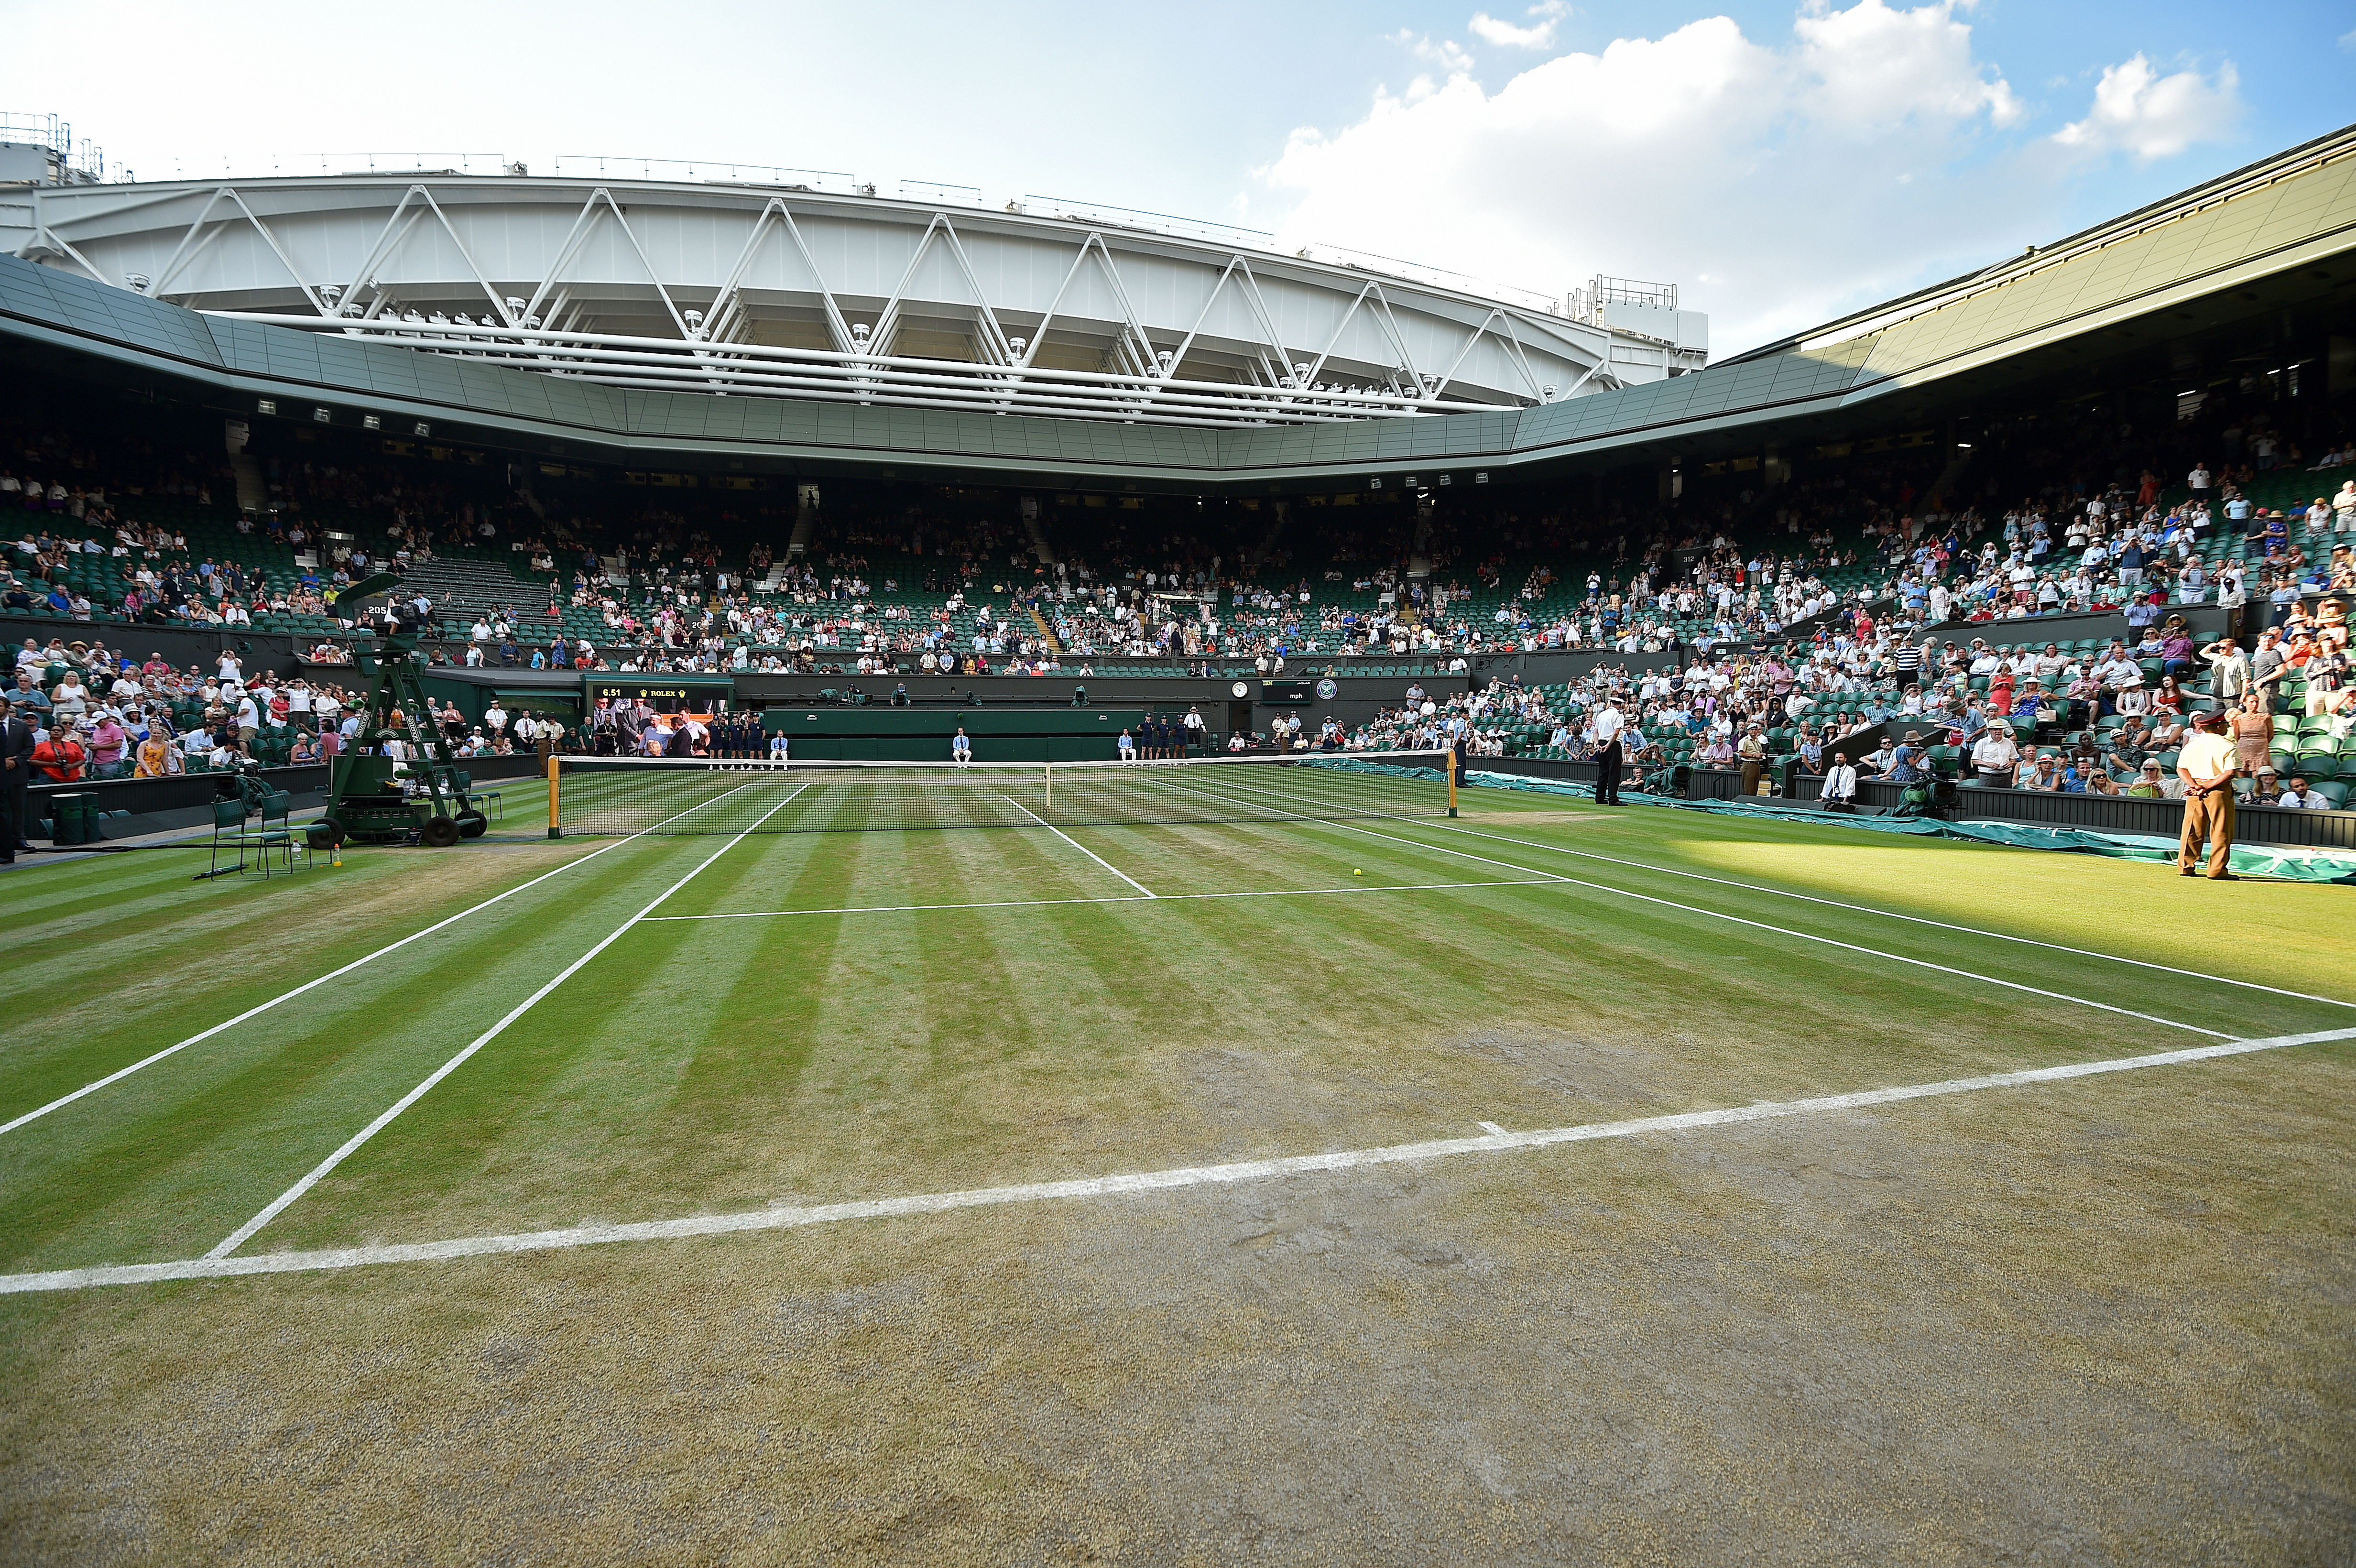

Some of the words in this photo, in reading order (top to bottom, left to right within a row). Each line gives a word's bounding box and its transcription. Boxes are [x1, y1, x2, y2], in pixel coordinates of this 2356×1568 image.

[368, 606, 387, 614] 205
[355, 710, 371, 738] Slazenger
[406, 715, 420, 742] Slazenger
